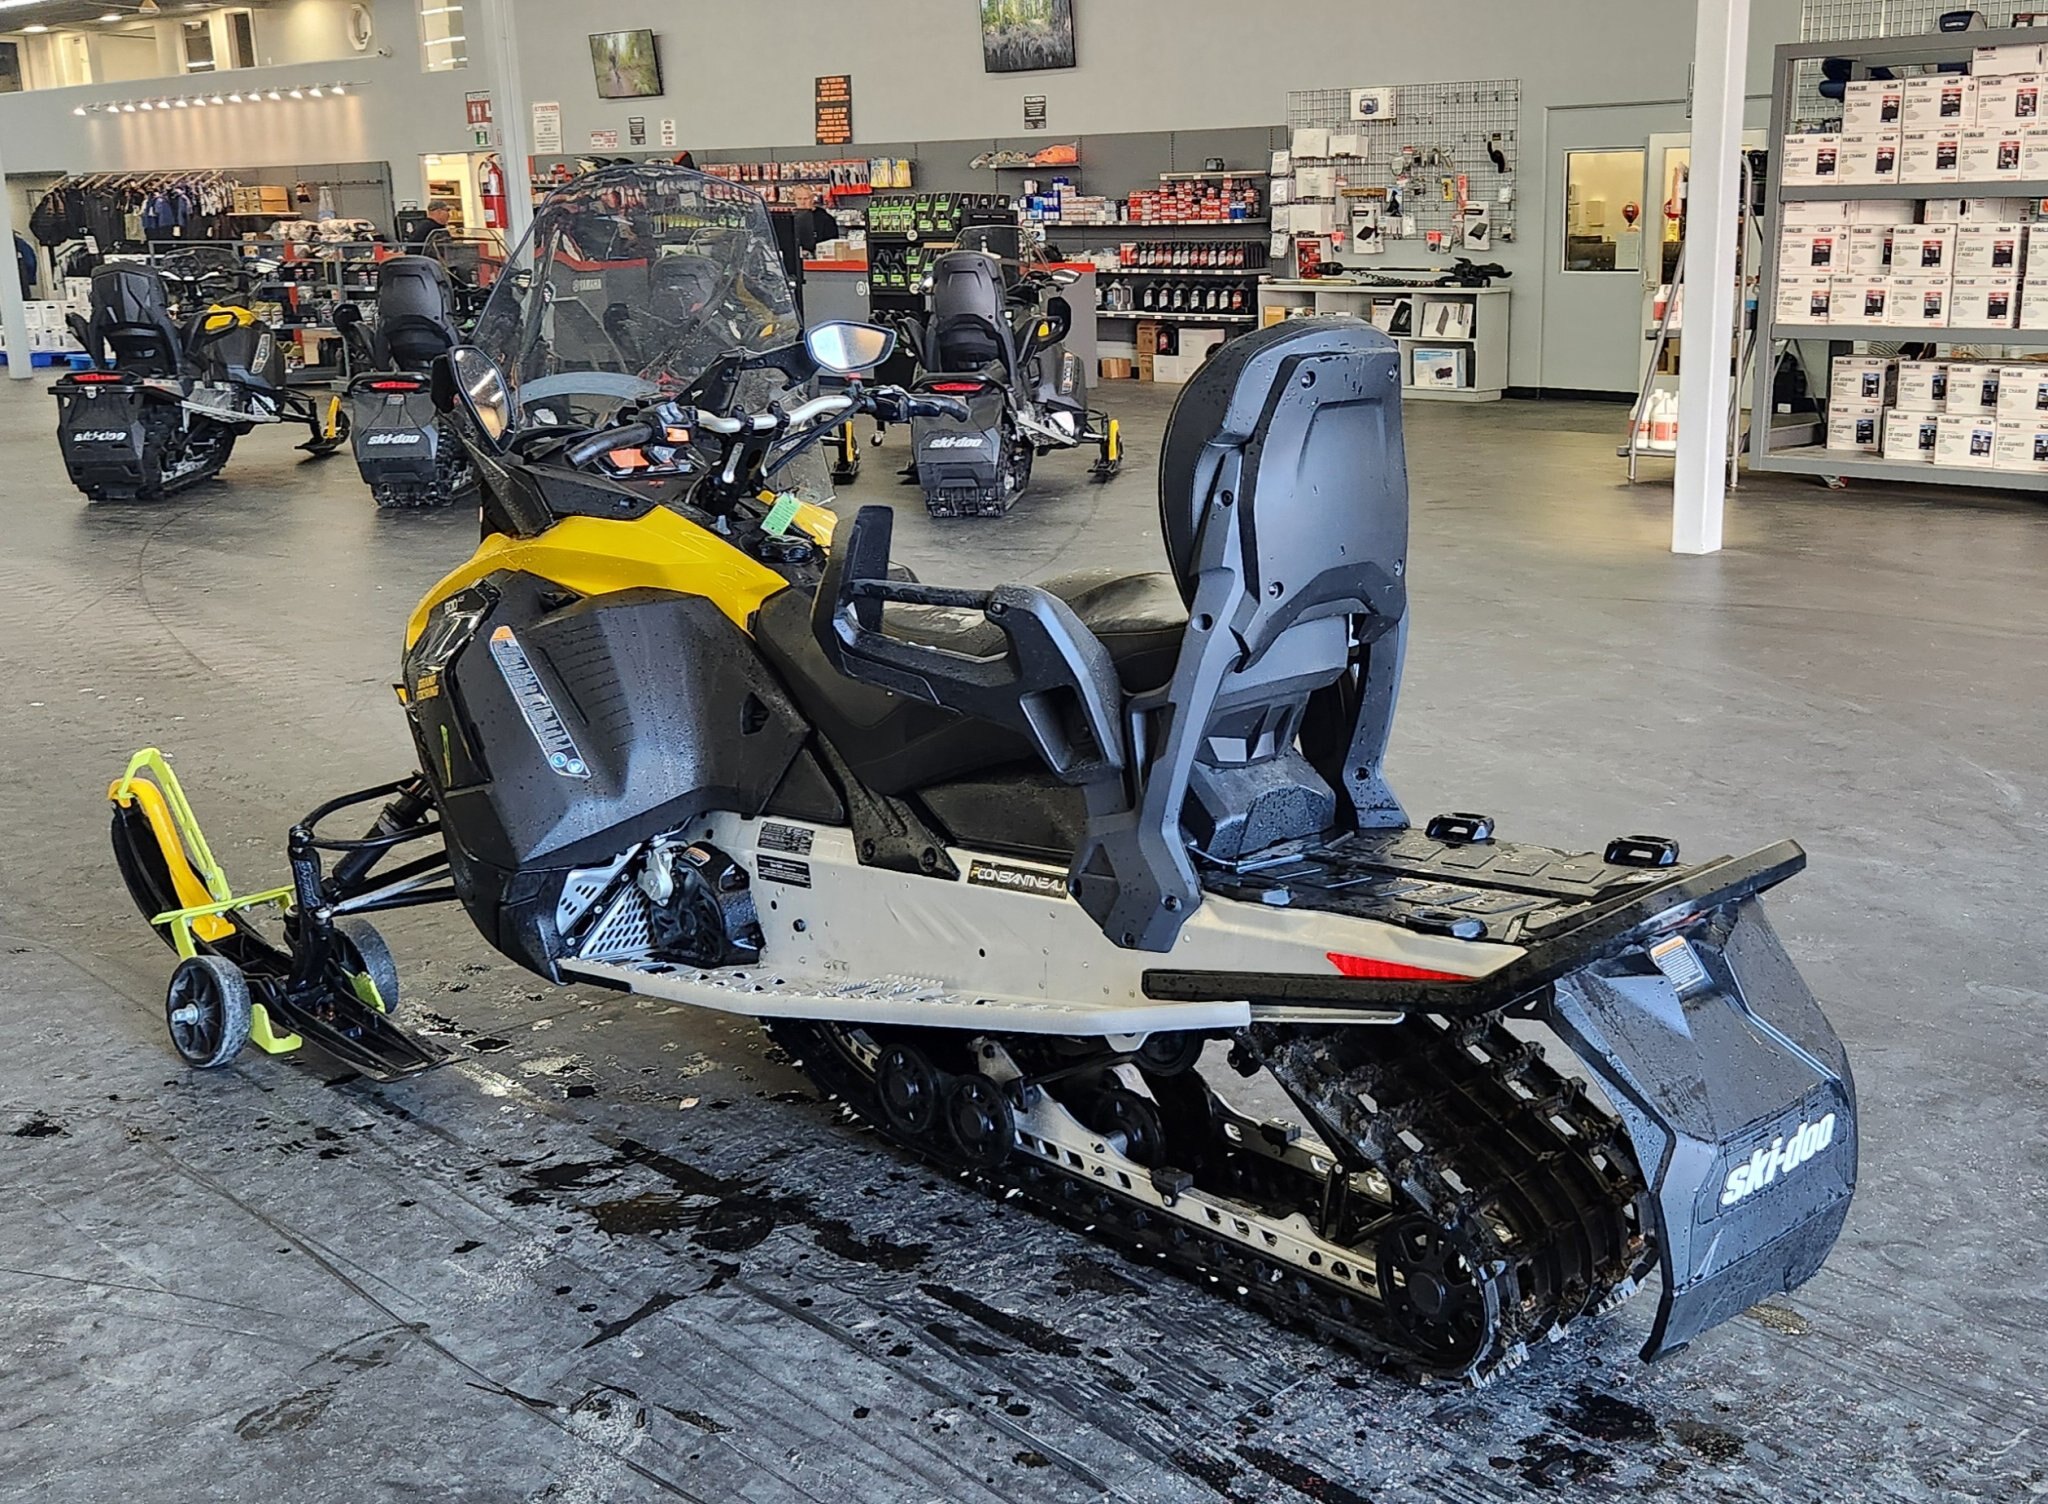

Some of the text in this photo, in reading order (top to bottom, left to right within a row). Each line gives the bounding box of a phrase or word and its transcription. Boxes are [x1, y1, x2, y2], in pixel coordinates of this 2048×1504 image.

[74, 430, 127, 441] ski-doo
[367, 433, 420, 445] ski-doo
[929, 436, 983, 448] ski-doo
[1720, 1113, 1836, 1205] ski-doo
